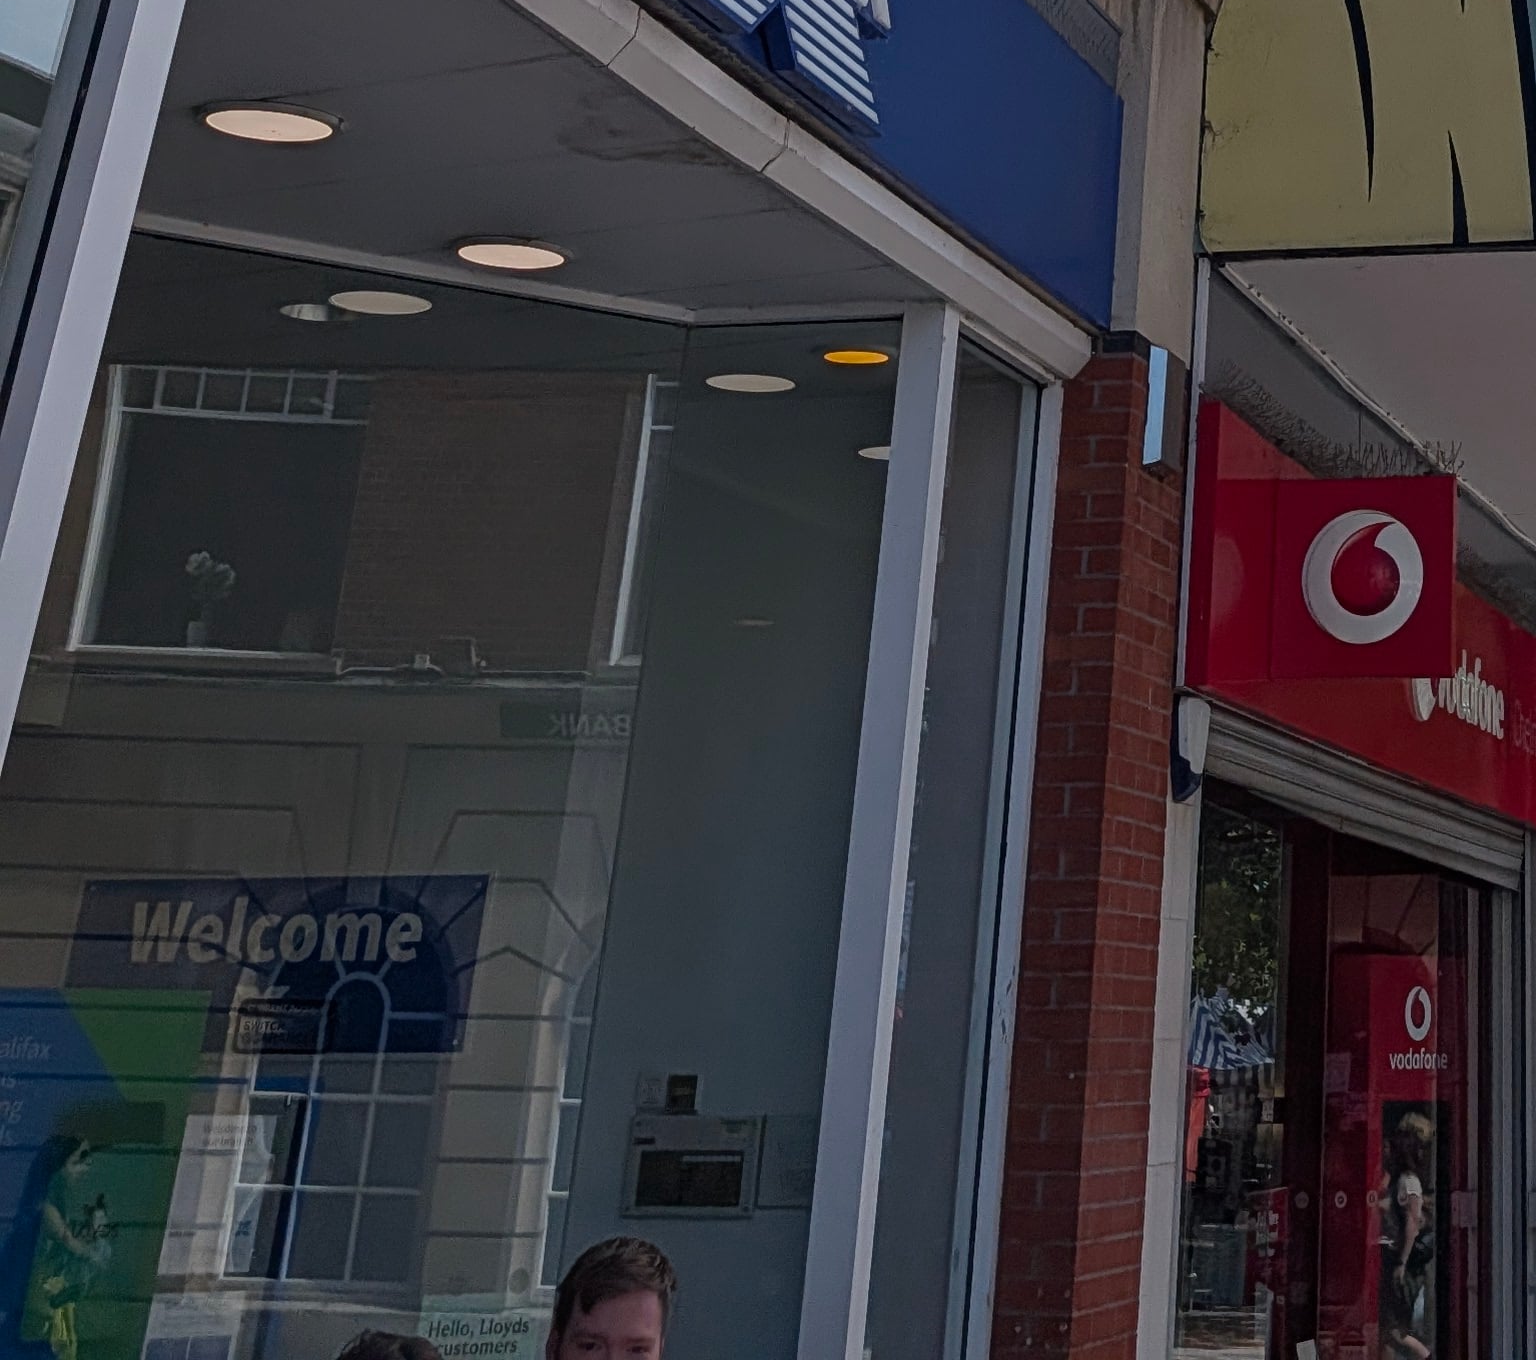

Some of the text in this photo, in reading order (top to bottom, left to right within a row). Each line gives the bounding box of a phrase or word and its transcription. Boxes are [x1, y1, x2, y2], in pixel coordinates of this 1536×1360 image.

[131, 896, 424, 964] Welcome
[0, 1036, 51, 1060] alifax
[1389, 1047, 1448, 1070] vodafone
[428, 1317, 530, 1339] Hello, Lloyds
